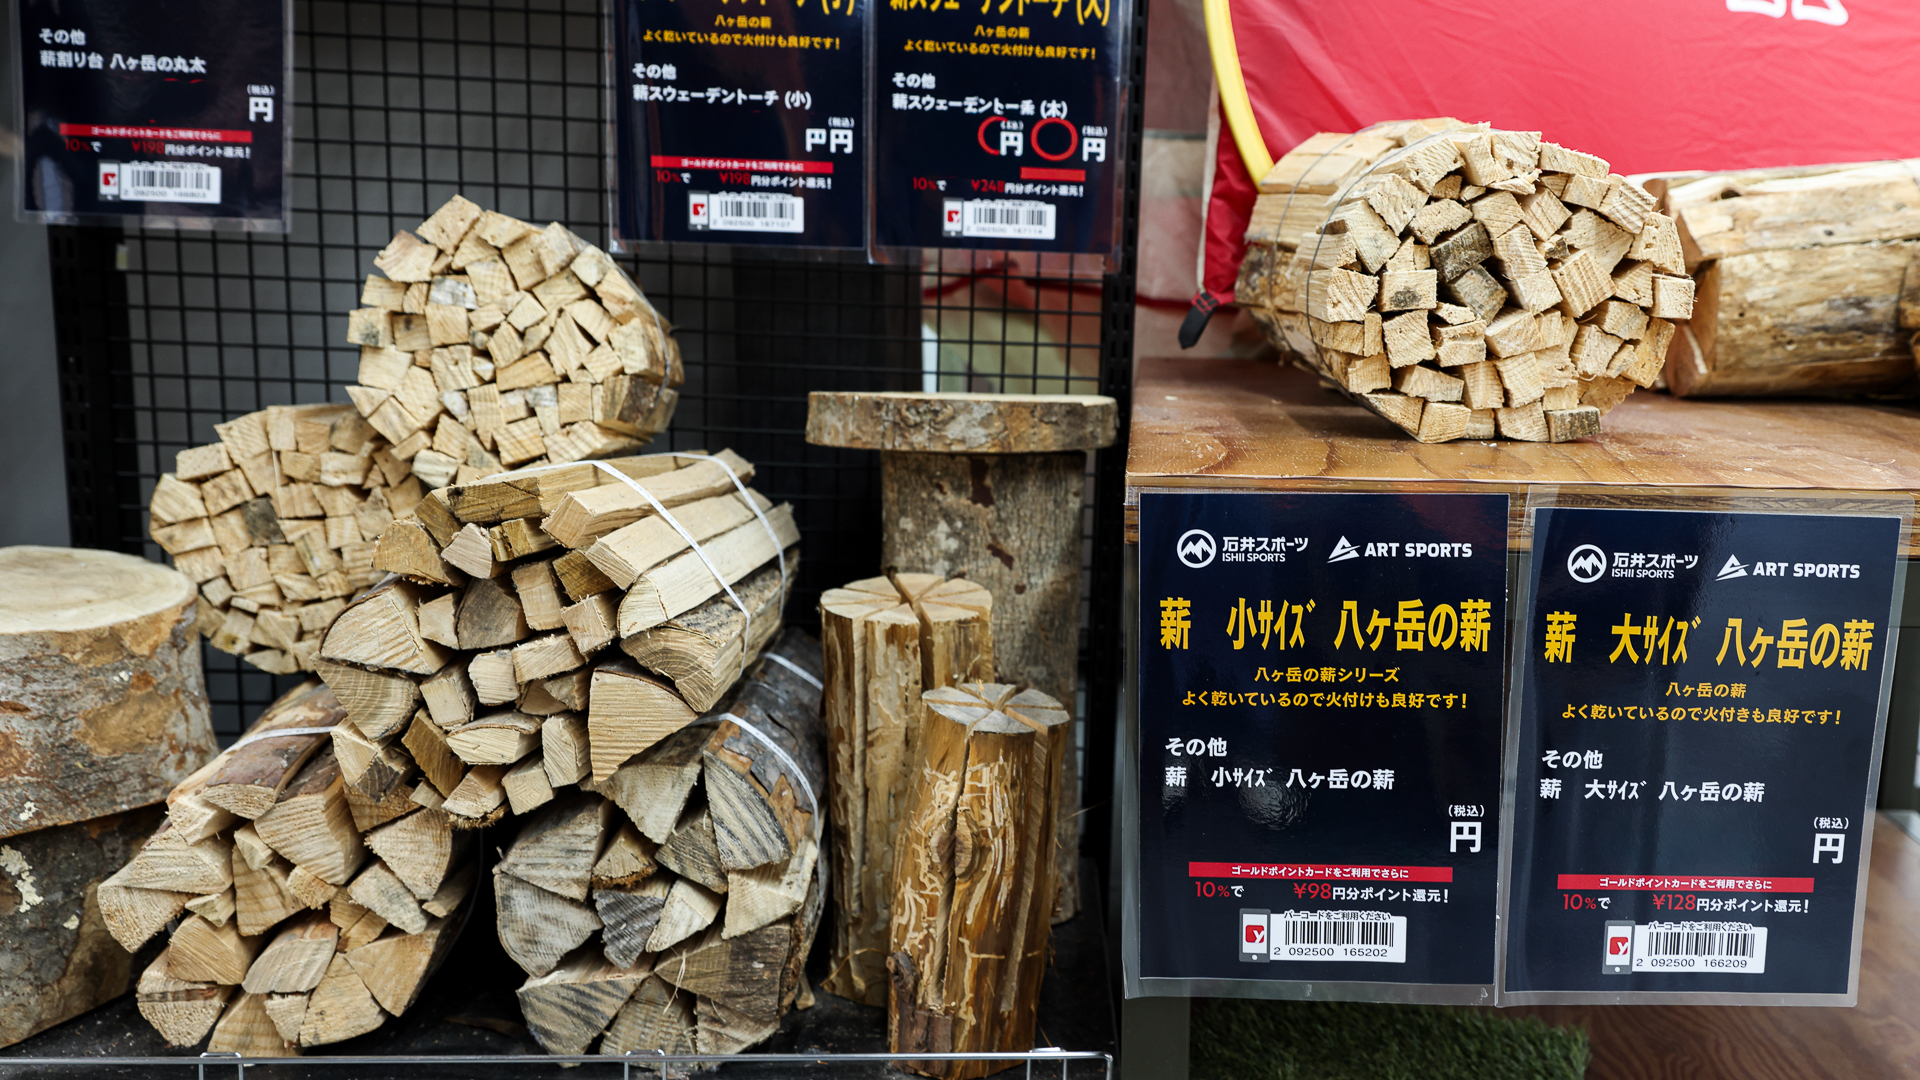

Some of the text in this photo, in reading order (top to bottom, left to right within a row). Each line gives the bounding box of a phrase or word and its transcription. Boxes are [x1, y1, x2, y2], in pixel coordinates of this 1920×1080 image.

[38, 28, 87, 47] その他
[40, 50, 208, 74] 薪割り台 八ヶ岳の丸太
[631, 62, 677, 81] その他
[891, 72, 936, 89] その他
[632, 83, 812, 110] 薪スウェーデントーチ (小)
[248, 97, 274, 122] 円
[1000, 131, 1106, 162] 円 円
[656, 170, 691, 184] 10%で
[913, 177, 947, 191] 10%で
[1222, 536, 1309, 553] 石井スポーツ
[1364, 542, 1473, 558] ART SPORTS
[1221, 552, 1286, 563] ISHII SPORTS
[1612, 552, 1699, 569] 石井スポーツ
[1611, 568, 1675, 579] ISHII SPORTS
[1752, 561, 1861, 579] ART SPORTS
[1160, 597, 1191, 650] 薪
[1334, 598, 1492, 652] 八ヶ岳の薪
[1544, 610, 1578, 663] 薪
[1715, 617, 1875, 671] 八ヶ岳の薪
[1254, 667, 1400, 683] 八ヶ岳の薪シリーズ
[1665, 682, 1747, 699] 八ヶ岳の薪
[1182, 691, 1468, 709] よく乾いているので火付けも良好です!
[1561, 703, 1842, 725] よく乾いているので火付きも良好です!
[1164, 737, 1228, 757] その他
[1541, 749, 1604, 769] その他
[1165, 766, 1187, 787] 薪
[1285, 768, 1395, 791] 八ヶ岳の薪
[1539, 778, 1562, 800] 薪
[1658, 780, 1766, 803] 八ヶ岳の薪
[1447, 804, 1486, 817] (税込)
[1813, 816, 1850, 829] (税込)
[1449, 821, 1482, 853] 円
[1812, 833, 1846, 864] 円
[1231, 865, 1409, 879] ゴールドポイントカードをご利用でさらに
[1195, 881, 1449, 903] 10%で ¥98円分ポイント還元!
[1599, 877, 1773, 890] ゴールドポイントカードをご利用でさらに
[1562, 893, 1810, 914] 10%で ¥128円分ポイント還元!
[1283, 910, 1391, 921] バーコードをご利用ください
[1647, 920, 1753, 932] バーコードをご利用ください
[1273, 946, 1388, 958] 2 092500 165202
[1636, 958, 1748, 969] 2 092500 166209
